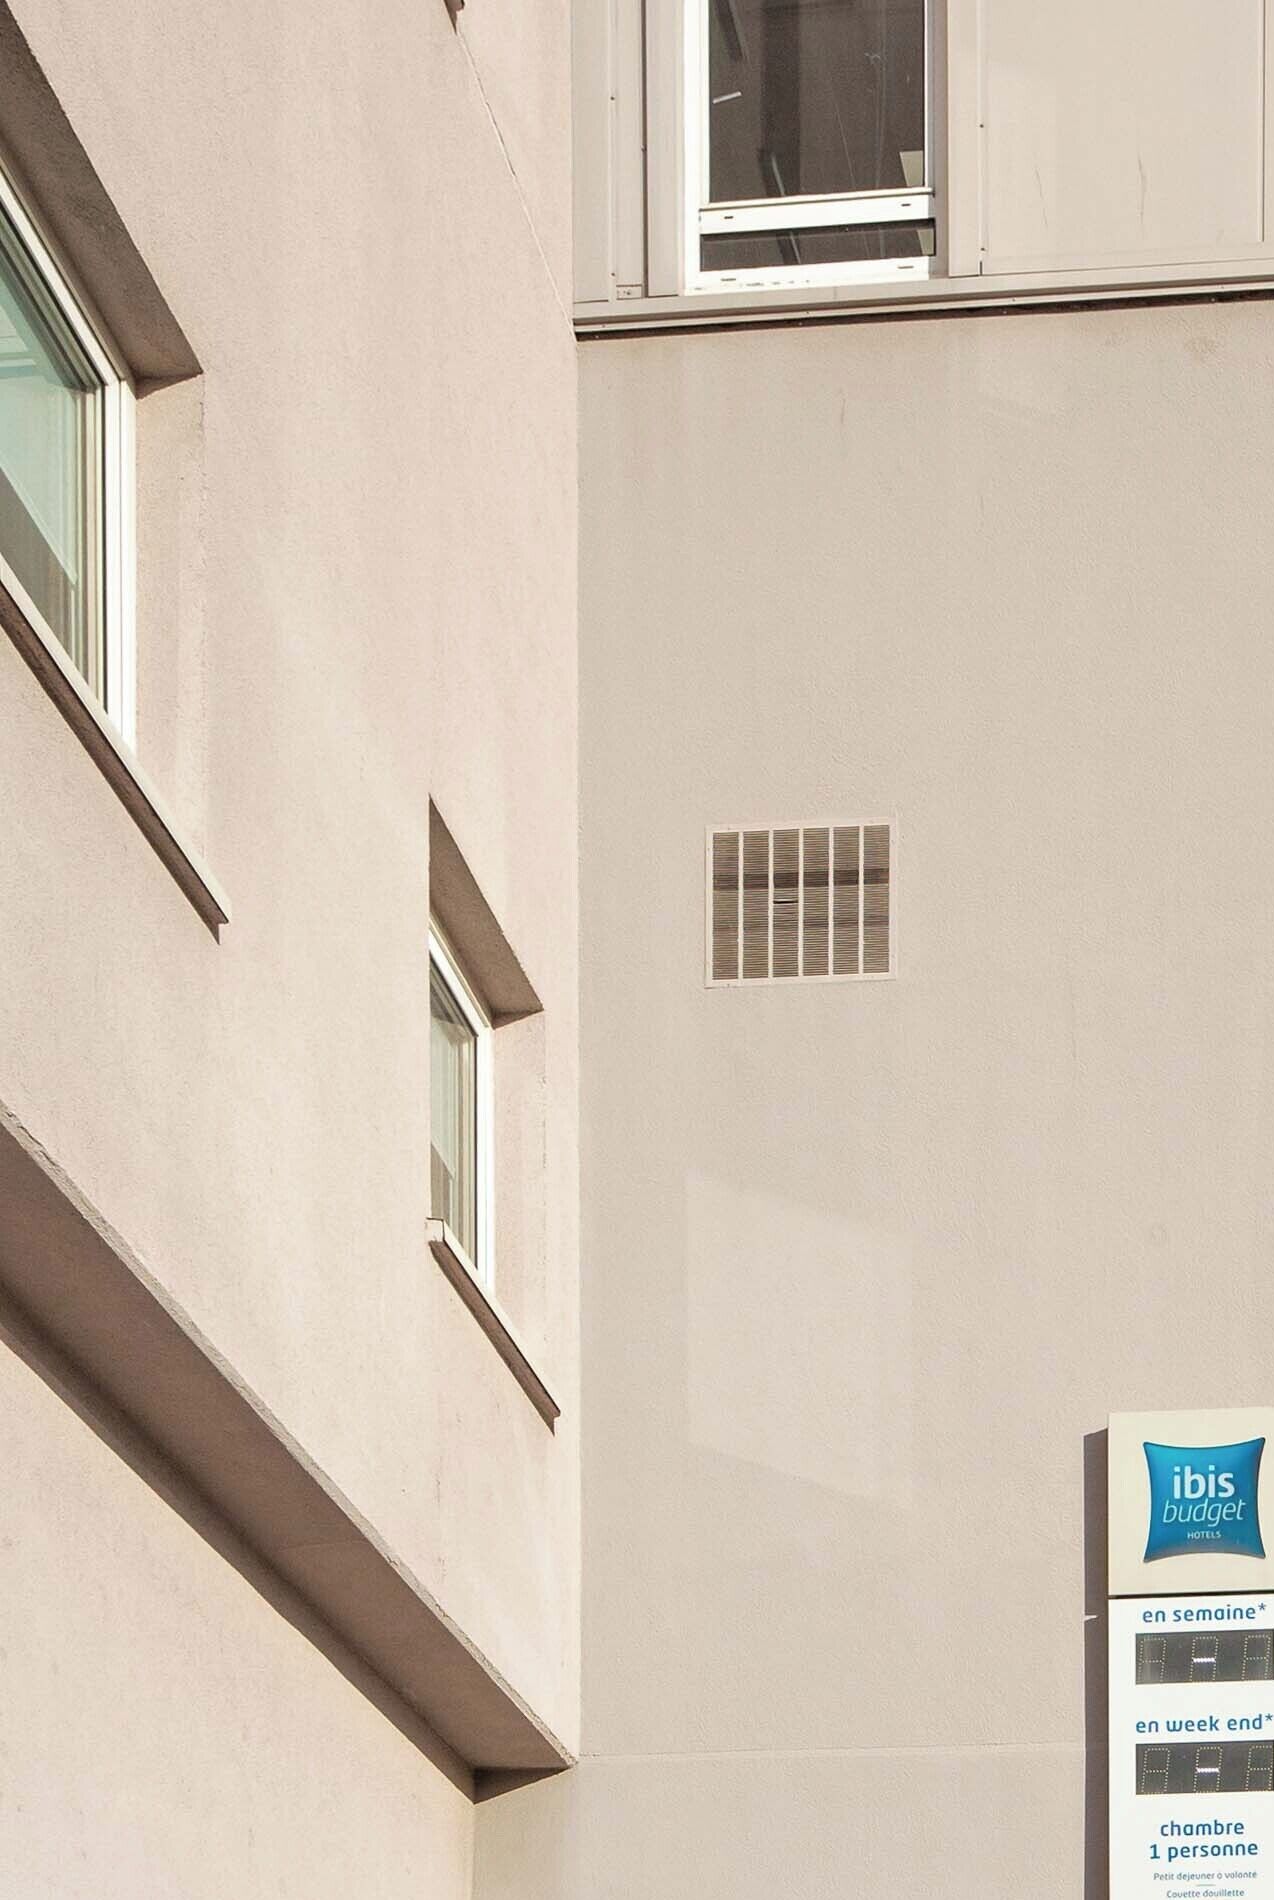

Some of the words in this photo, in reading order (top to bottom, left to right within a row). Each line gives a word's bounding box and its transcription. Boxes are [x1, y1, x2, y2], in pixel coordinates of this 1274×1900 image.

[1173, 1464, 1236, 1500] ibis
[1162, 1498, 1247, 1527] budget
[1186, 1530, 1222, 1540] HOTELS
[1142, 1610, 1166, 1623] en
[1135, 1720, 1159, 1733] en
[1166, 1715, 1220, 1732] week
[1160, 1819, 1245, 1837] chambre
[1149, 1844, 1161, 1860] 1
[1167, 1842, 1259, 1863] personne
[1153, 1872, 1175, 1881] Petit
[1166, 1889, 1201, 1899] Couette
[1202, 1888, 1245, 1898] douillette
